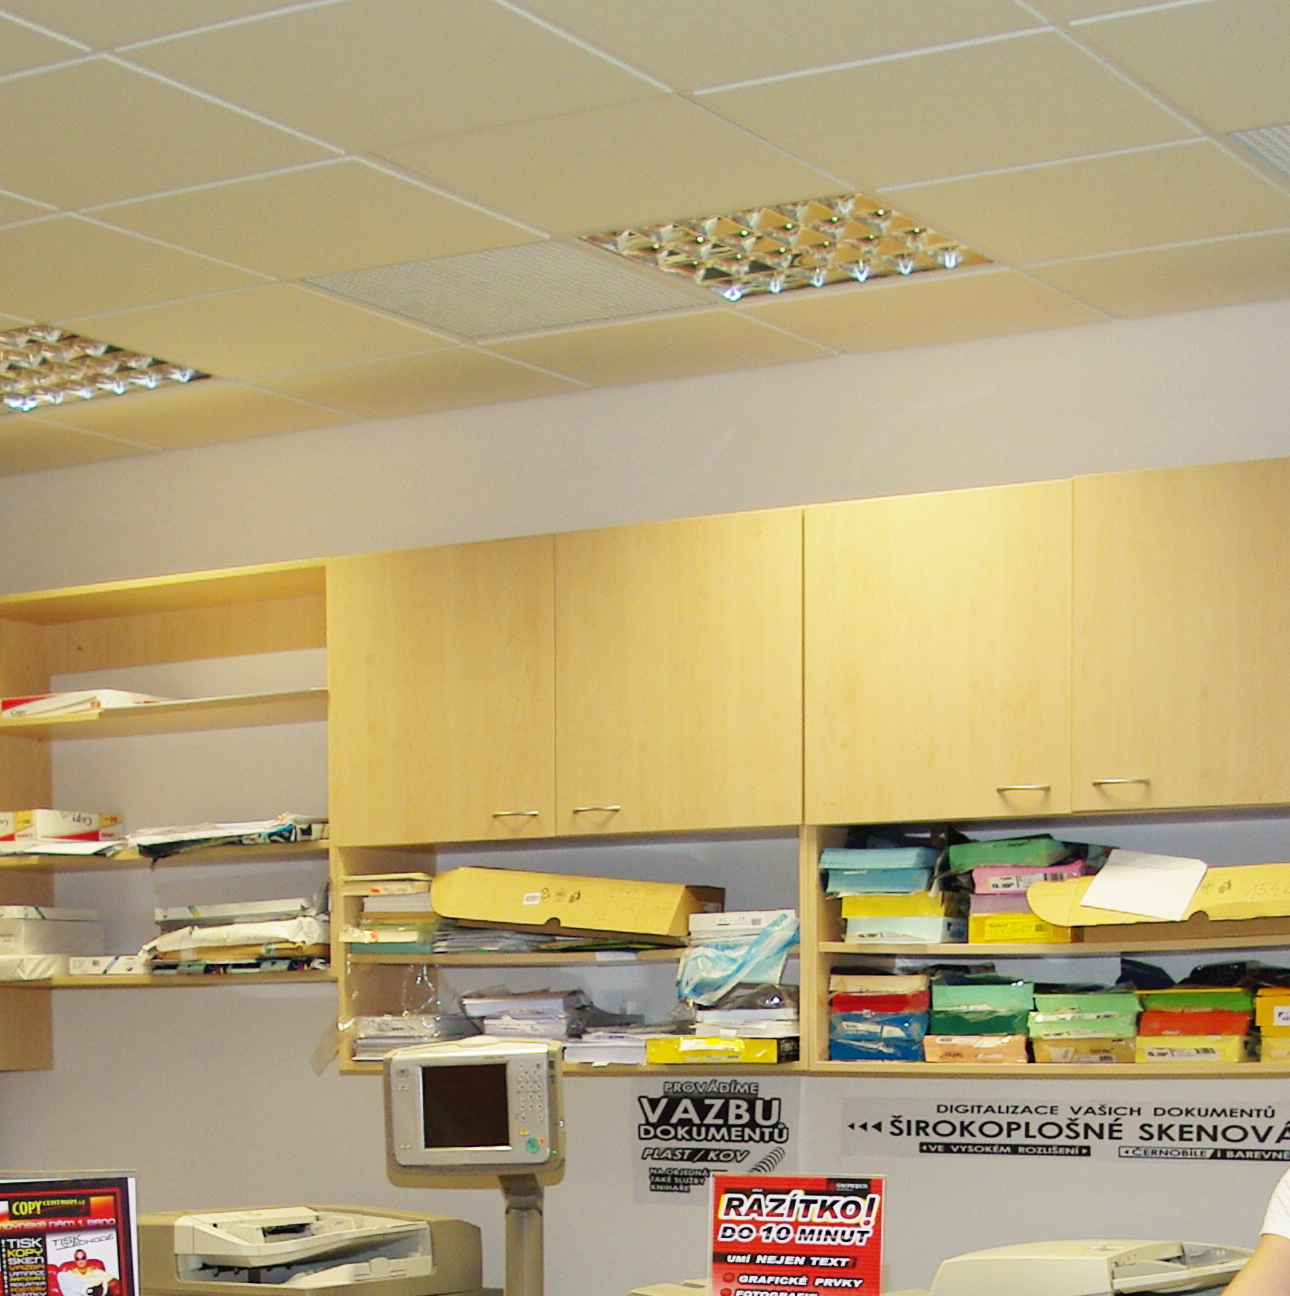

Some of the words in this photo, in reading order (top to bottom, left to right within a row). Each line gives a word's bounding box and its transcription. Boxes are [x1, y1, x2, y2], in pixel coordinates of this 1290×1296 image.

[663, 1079, 759, 1095] PROVÁDÍME
[639, 1096, 781, 1127] VAZBU
[936, 1103, 1059, 1115] DIGITALIZACE
[1070, 1102, 1141, 1117] VAŠICH
[1153, 1105, 1276, 1118] DOKUMENTŮ
[638, 1123, 789, 1143] DOKUMENTŮ
[889, 1115, 1123, 1141] ŠIROKOPLOŠNÉ
[641, 1148, 691, 1160] PLAST
[708, 1148, 750, 1162] KOV
[926, 1144, 945, 1152] VE
[951, 1143, 1012, 1154] VYSOKÉM
[1018, 1144, 1081, 1155] ROZLIŠENÍ
[720, 1189, 879, 1227] RAZÍTKO!
[720, 1225, 754, 1243] DO
[760, 1224, 791, 1243] 10
[797, 1226, 872, 1245] MINUT
[6, 1237, 43, 1249] TISK
[7, 1248, 44, 1258] KOPY
[727, 1253, 751, 1264] UMÍ
[756, 1255, 806, 1266] NEJEN
[810, 1256, 850, 1267] TEXT
[738, 1274, 808, 1286] GRAFICKÉ
[814, 1277, 863, 1288] PRVKY
